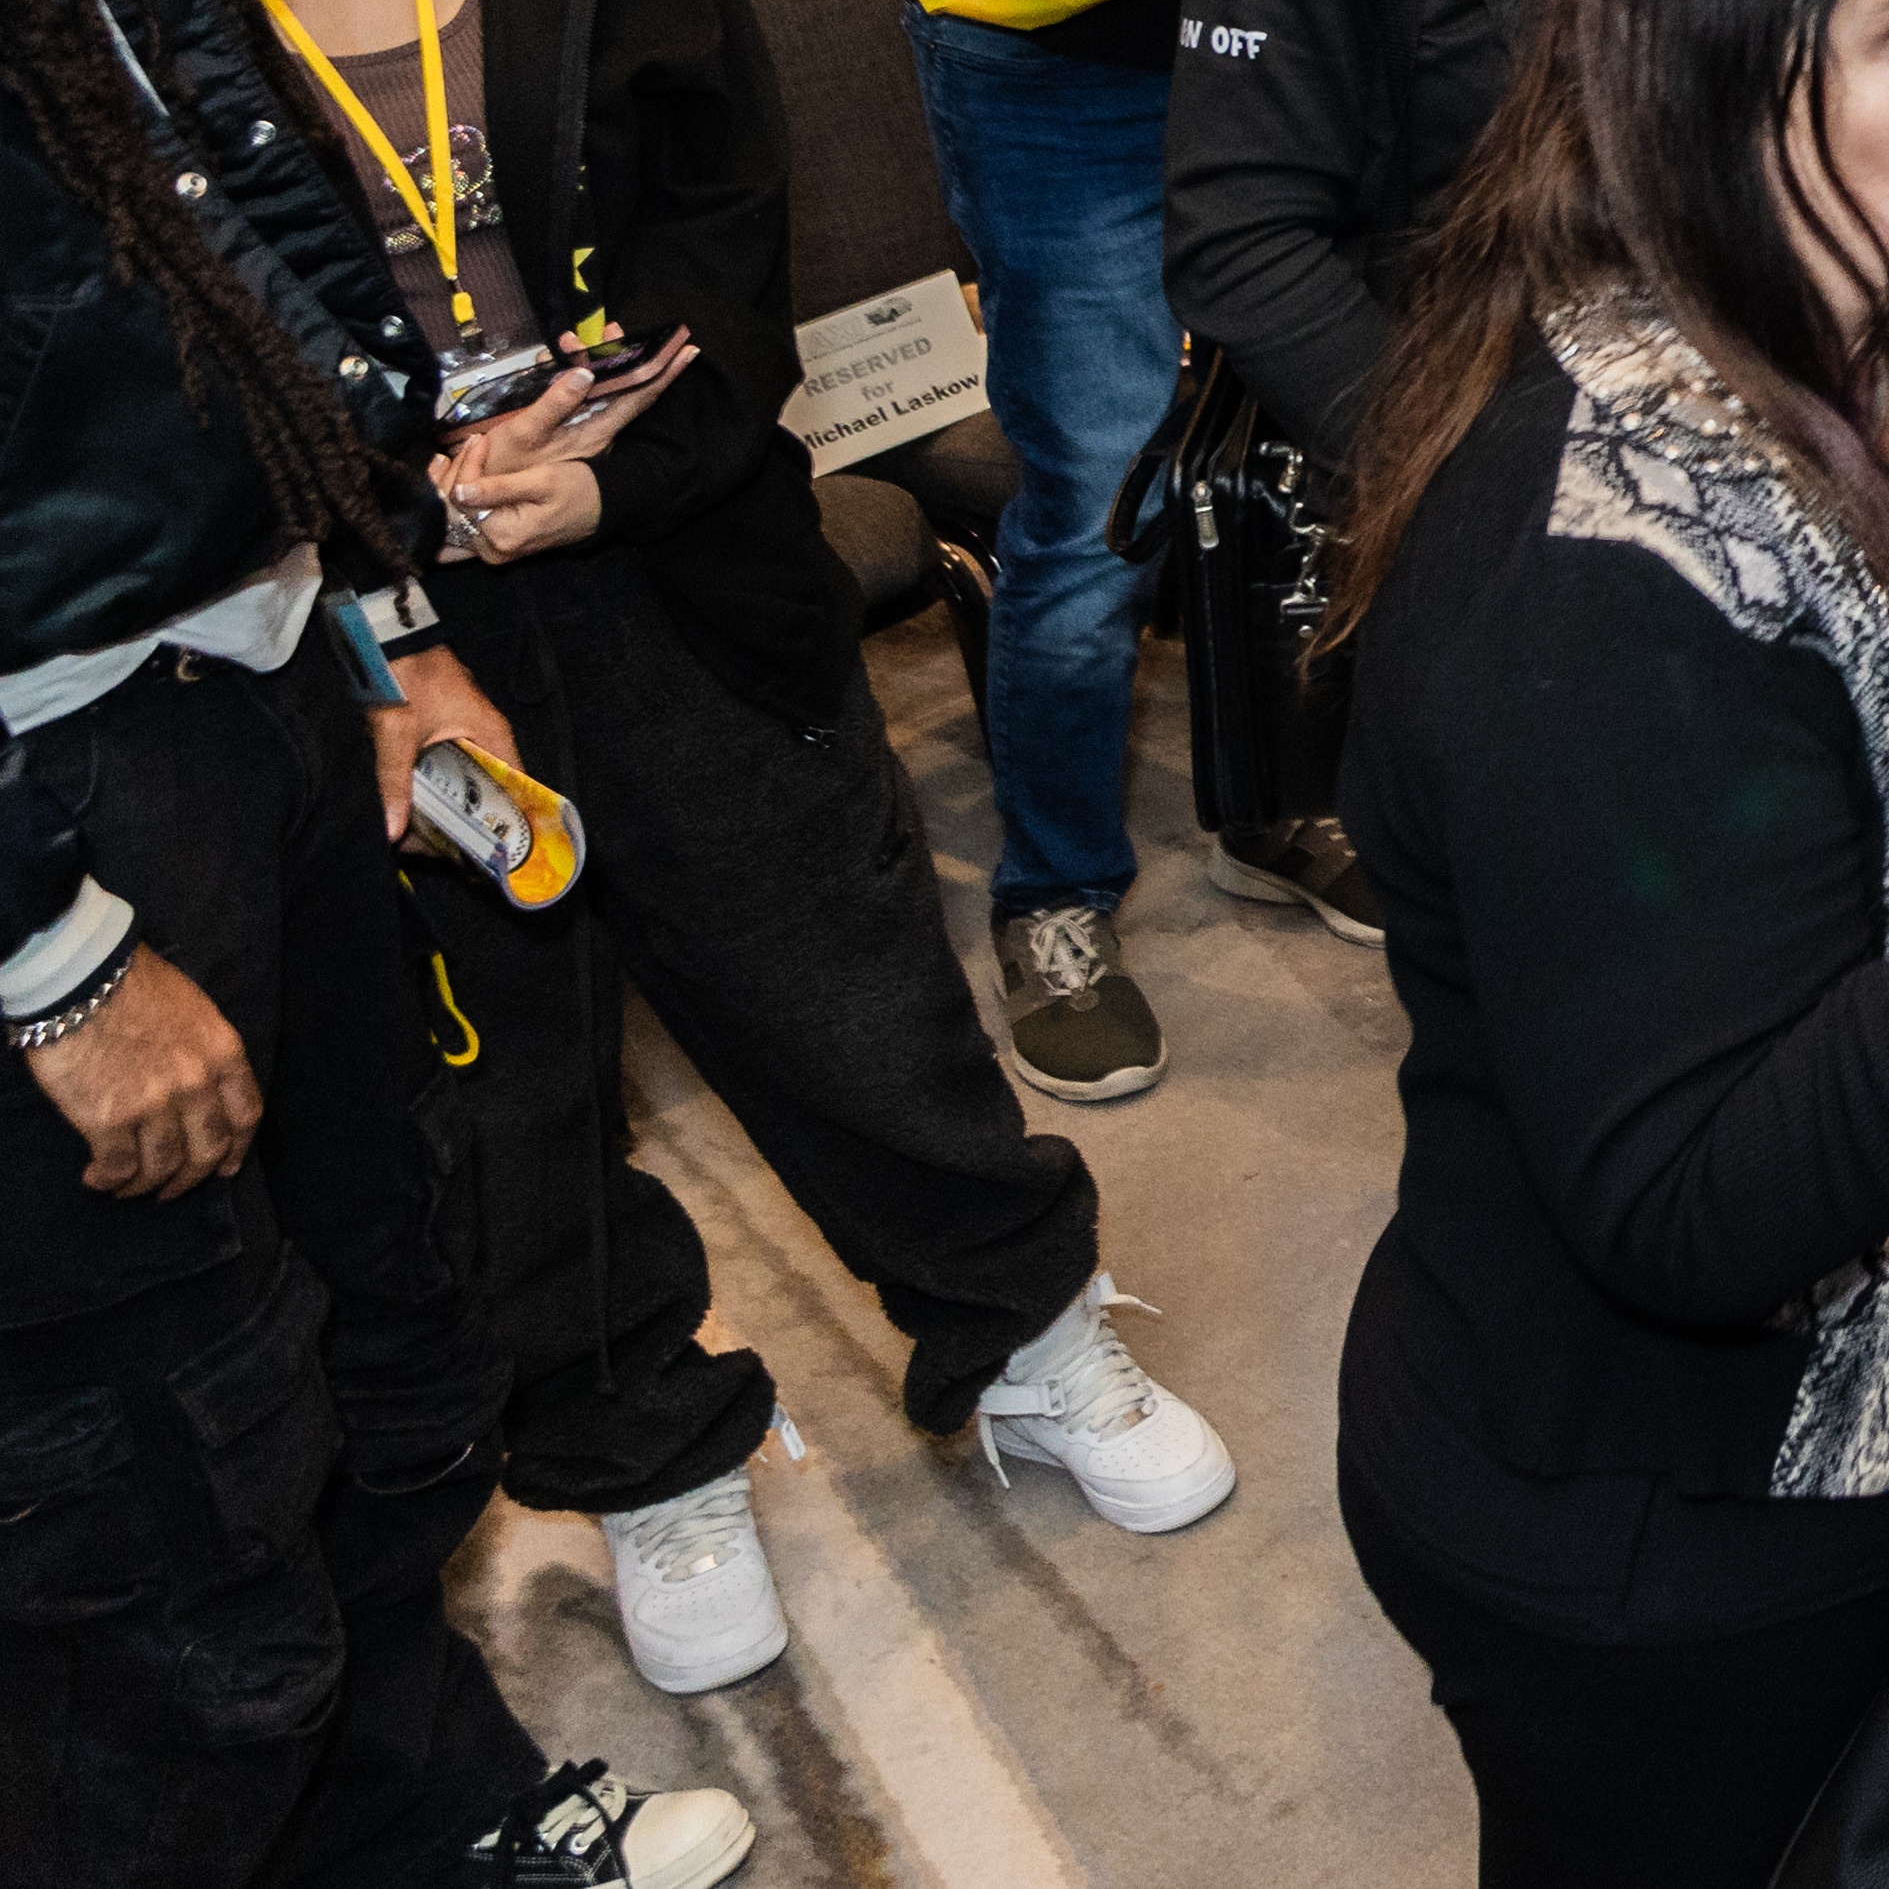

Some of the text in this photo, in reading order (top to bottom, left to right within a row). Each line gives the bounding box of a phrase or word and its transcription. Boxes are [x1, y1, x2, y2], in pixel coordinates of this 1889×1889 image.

[1211, 25, 1267, 60] OFF
[803, 337, 932, 398] RESERVED
[860, 379, 895, 402] for
[891, 373, 980, 416] Laskow
